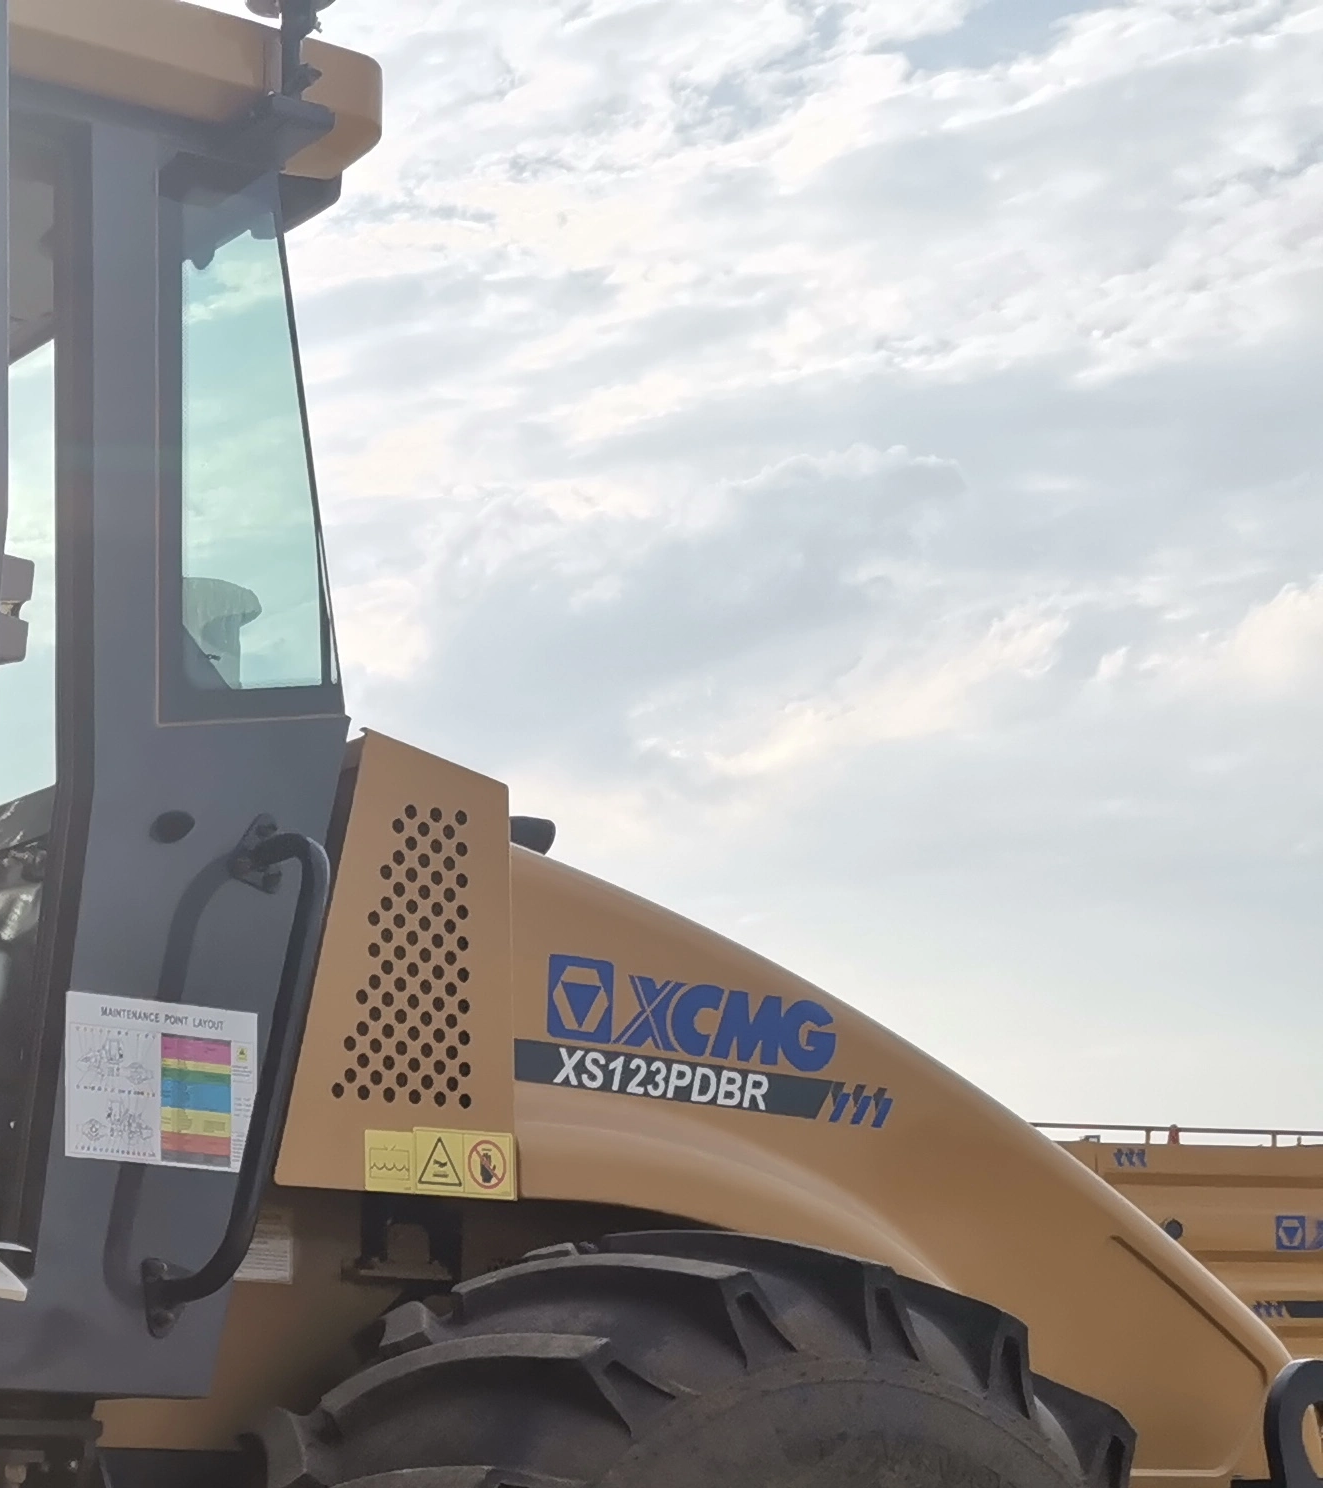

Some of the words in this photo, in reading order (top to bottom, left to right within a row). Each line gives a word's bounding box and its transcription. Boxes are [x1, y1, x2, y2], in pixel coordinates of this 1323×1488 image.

[100, 1006, 160, 1023] MAINTENANCE
[164, 1013, 188, 1026] POINT
[192, 1017, 224, 1031] LAYOUT
[612, 974, 836, 1073] XCMG
[553, 1047, 770, 1111] XS123PDBR
